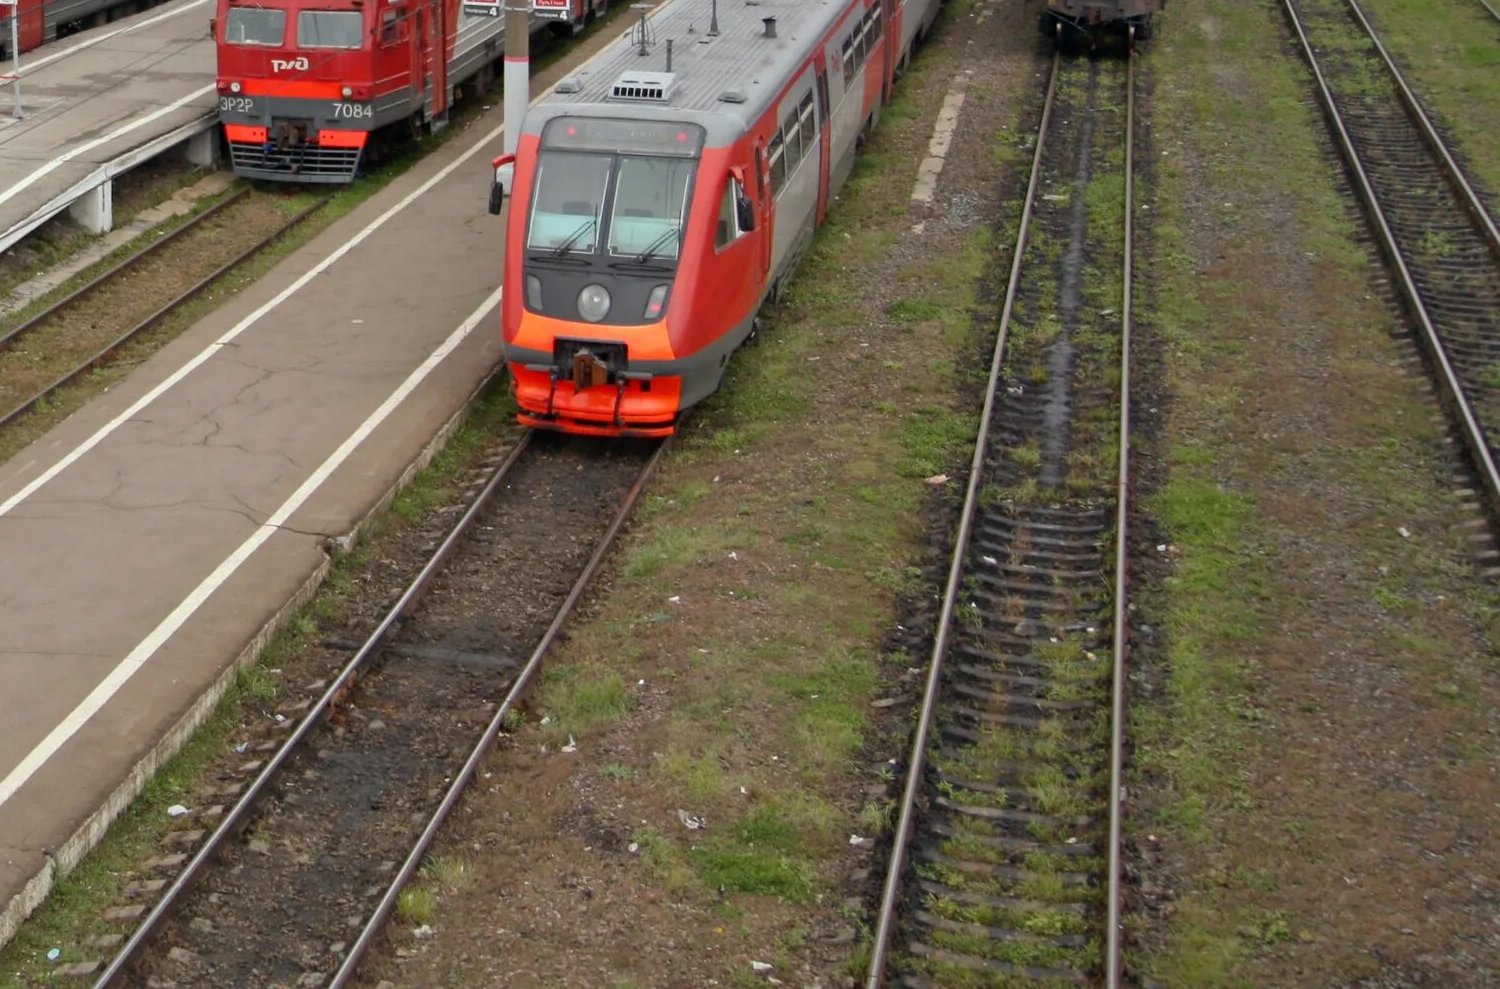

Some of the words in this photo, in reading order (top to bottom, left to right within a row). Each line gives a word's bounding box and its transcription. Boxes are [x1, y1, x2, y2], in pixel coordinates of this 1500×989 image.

[489, 7, 497, 16] 4
[560, 11, 567, 20] 4
[220, 97, 253, 112] ЭР2Р
[332, 103, 373, 118] 7084
